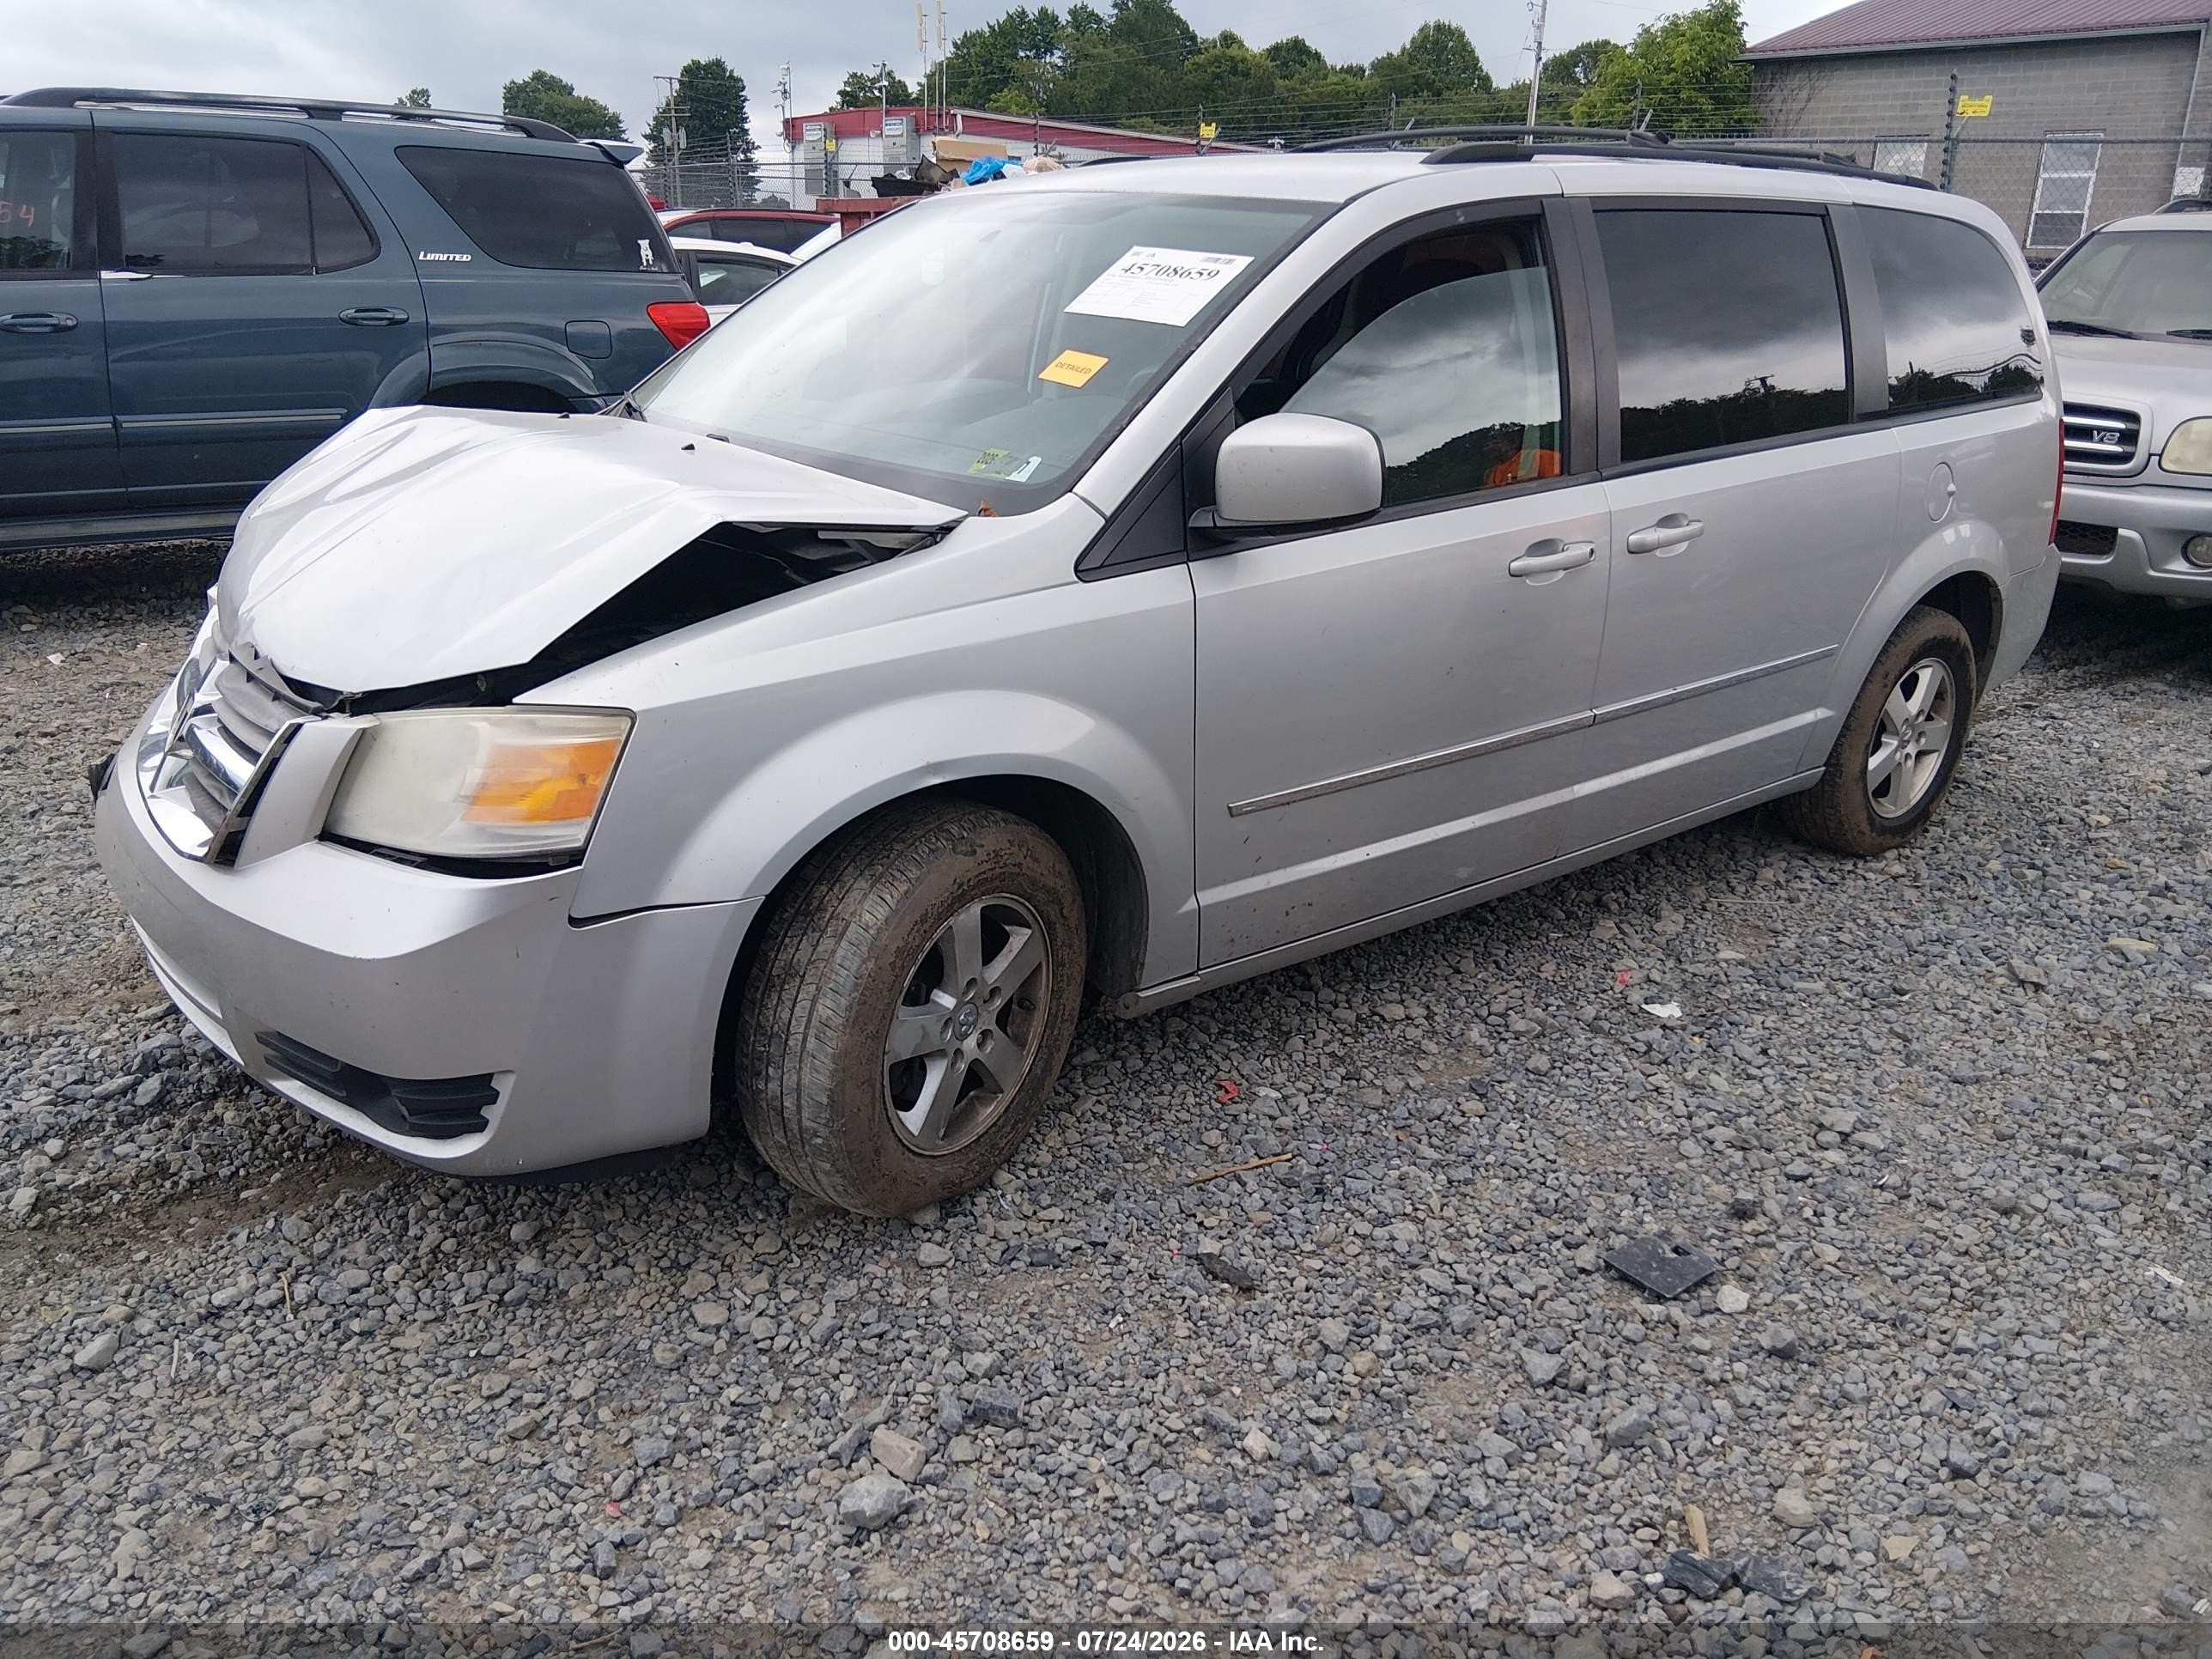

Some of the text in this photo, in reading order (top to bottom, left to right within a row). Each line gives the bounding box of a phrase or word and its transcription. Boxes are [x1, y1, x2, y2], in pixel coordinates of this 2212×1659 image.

[418, 251, 472, 262] LIMITED
[1121, 262, 1220, 281] 45708659
[1054, 361, 1092, 374] DETAILED
[2093, 429, 2120, 444] V8
